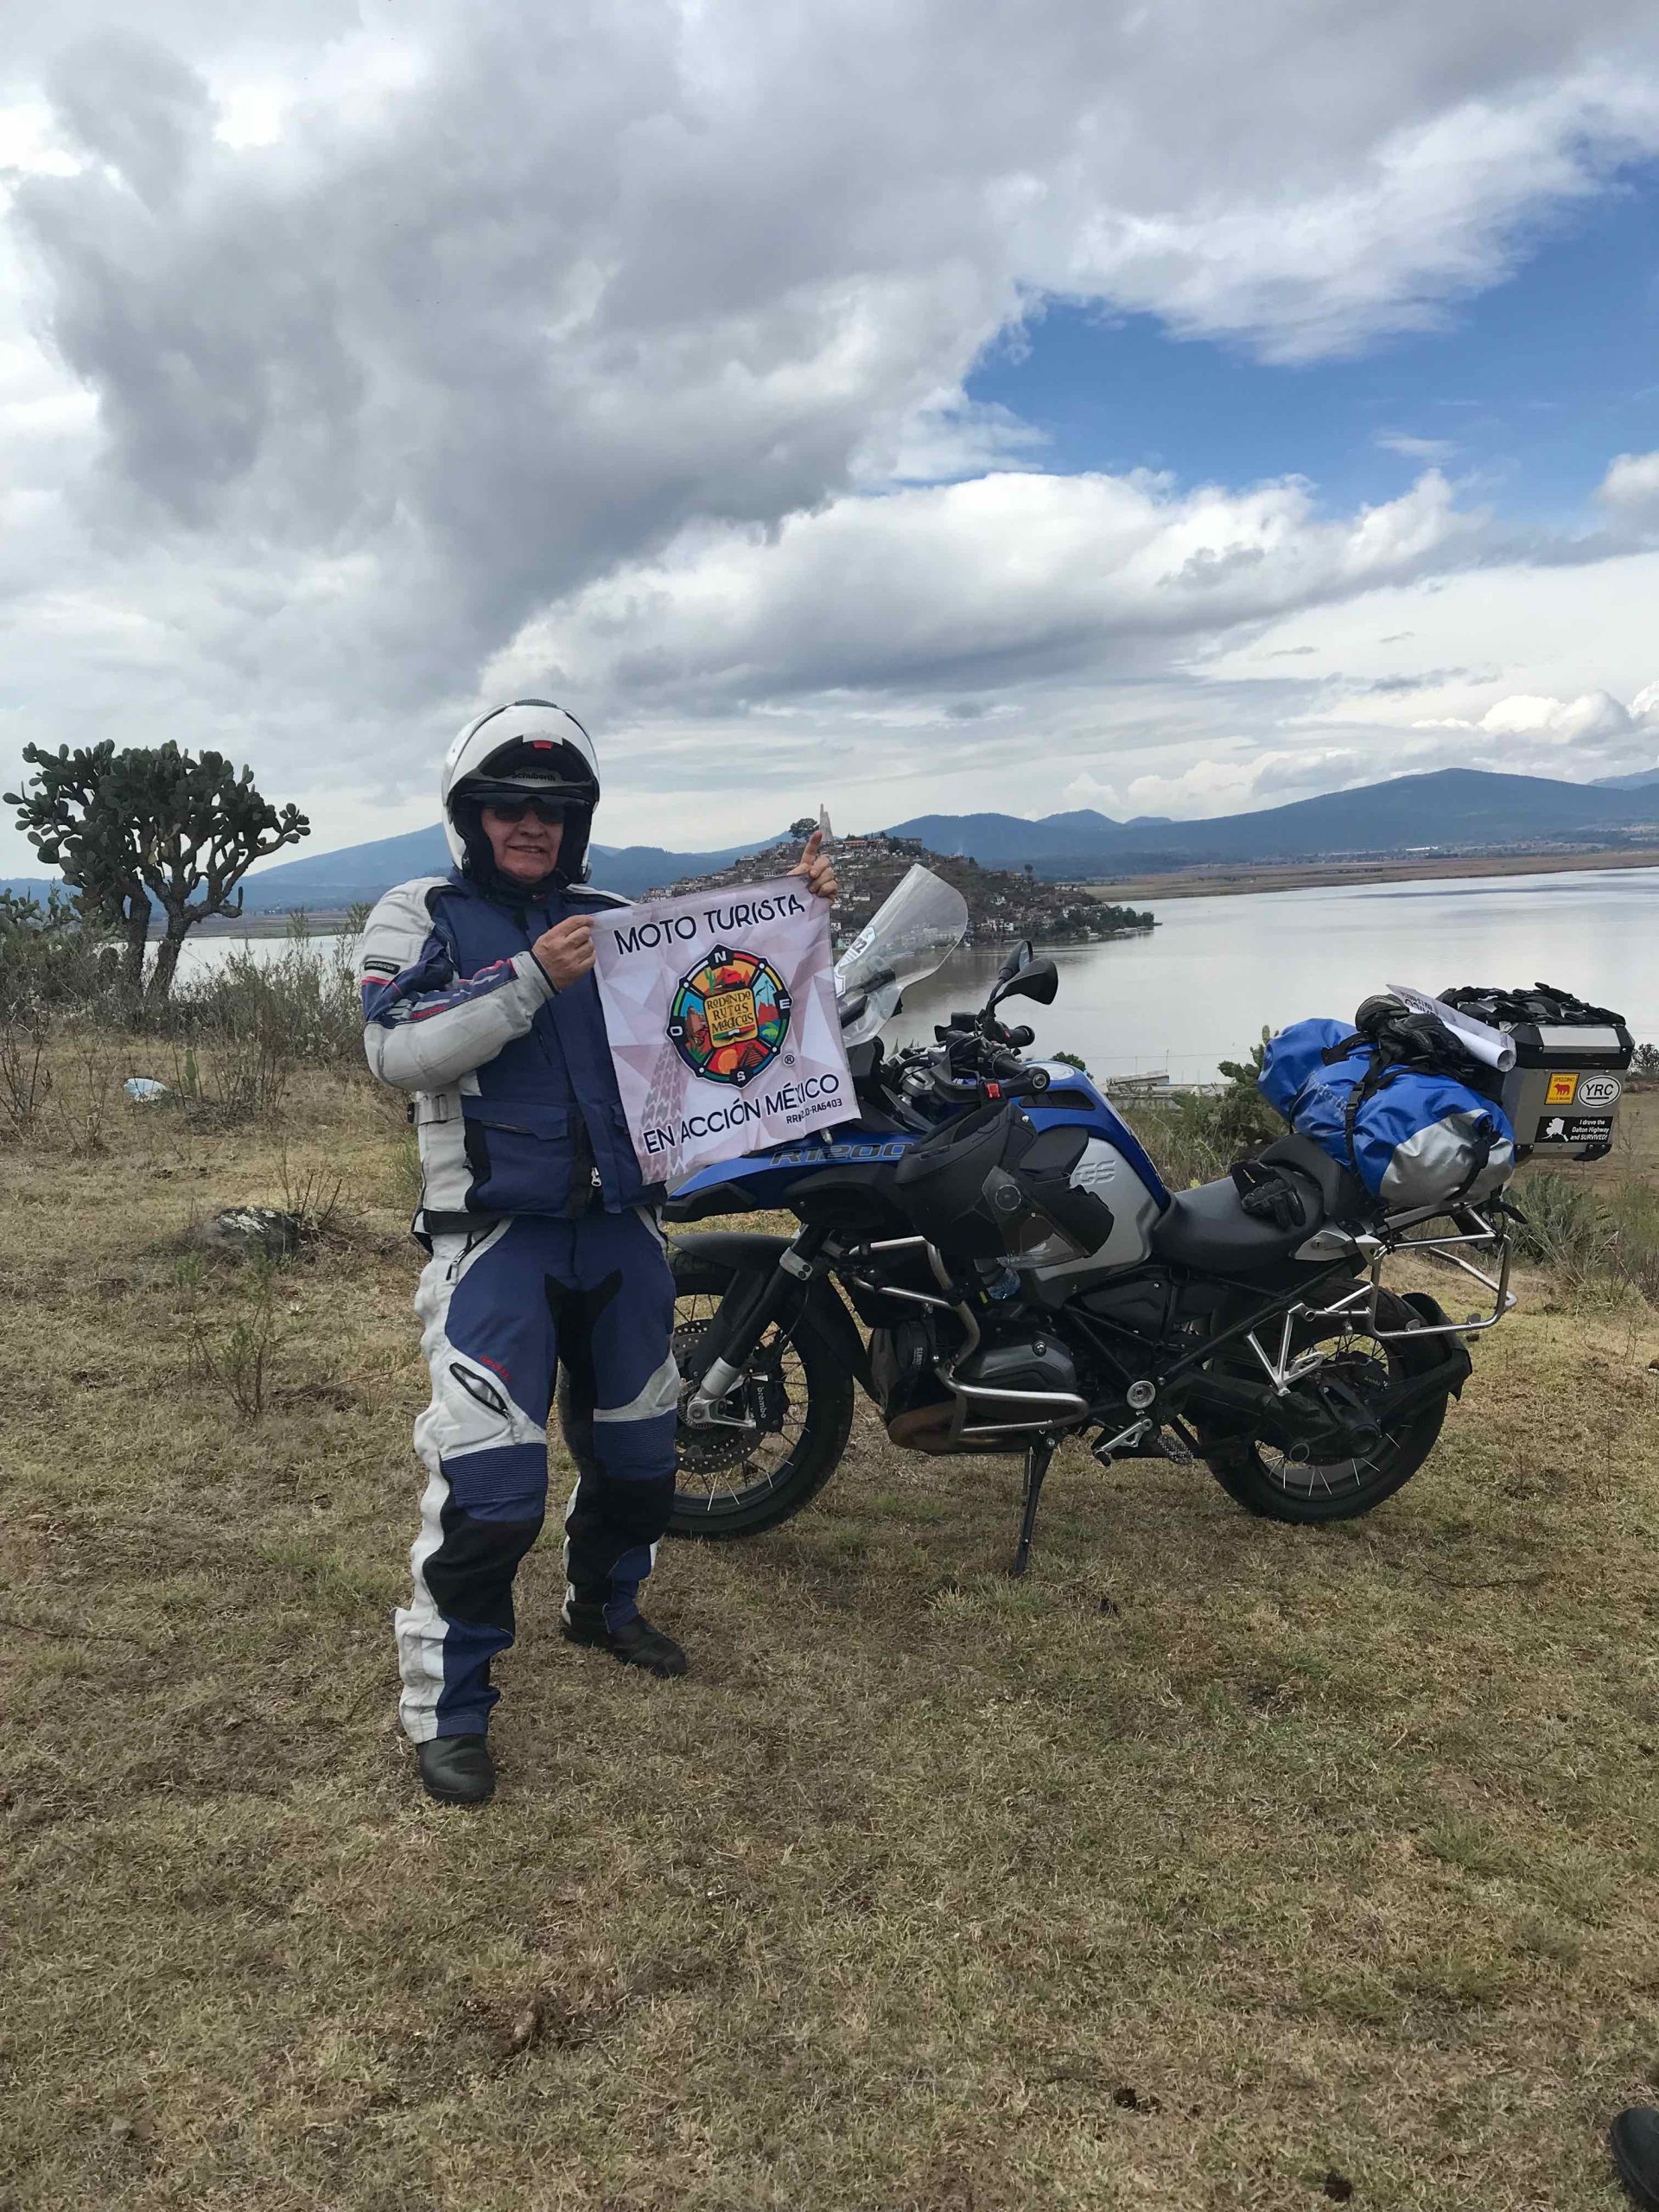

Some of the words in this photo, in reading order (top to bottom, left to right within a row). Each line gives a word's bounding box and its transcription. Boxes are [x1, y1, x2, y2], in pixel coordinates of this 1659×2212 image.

[613, 916, 696, 955] MOTO
[703, 894, 805, 933] TURISTA
[715, 951, 727, 963] N
[779, 999, 791, 1009] E
[670, 1027, 683, 1036] O
[737, 1071, 746, 1081] S
[1586, 1084, 1614, 1096] YRC
[643, 1125, 676, 1154] EN
[681, 1098, 761, 1143] ACCIÓN
[765, 1073, 840, 1116] MÉXICO
[1074, 1160, 1116, 1185] GS
[757, 1386, 767, 1419] brembo
